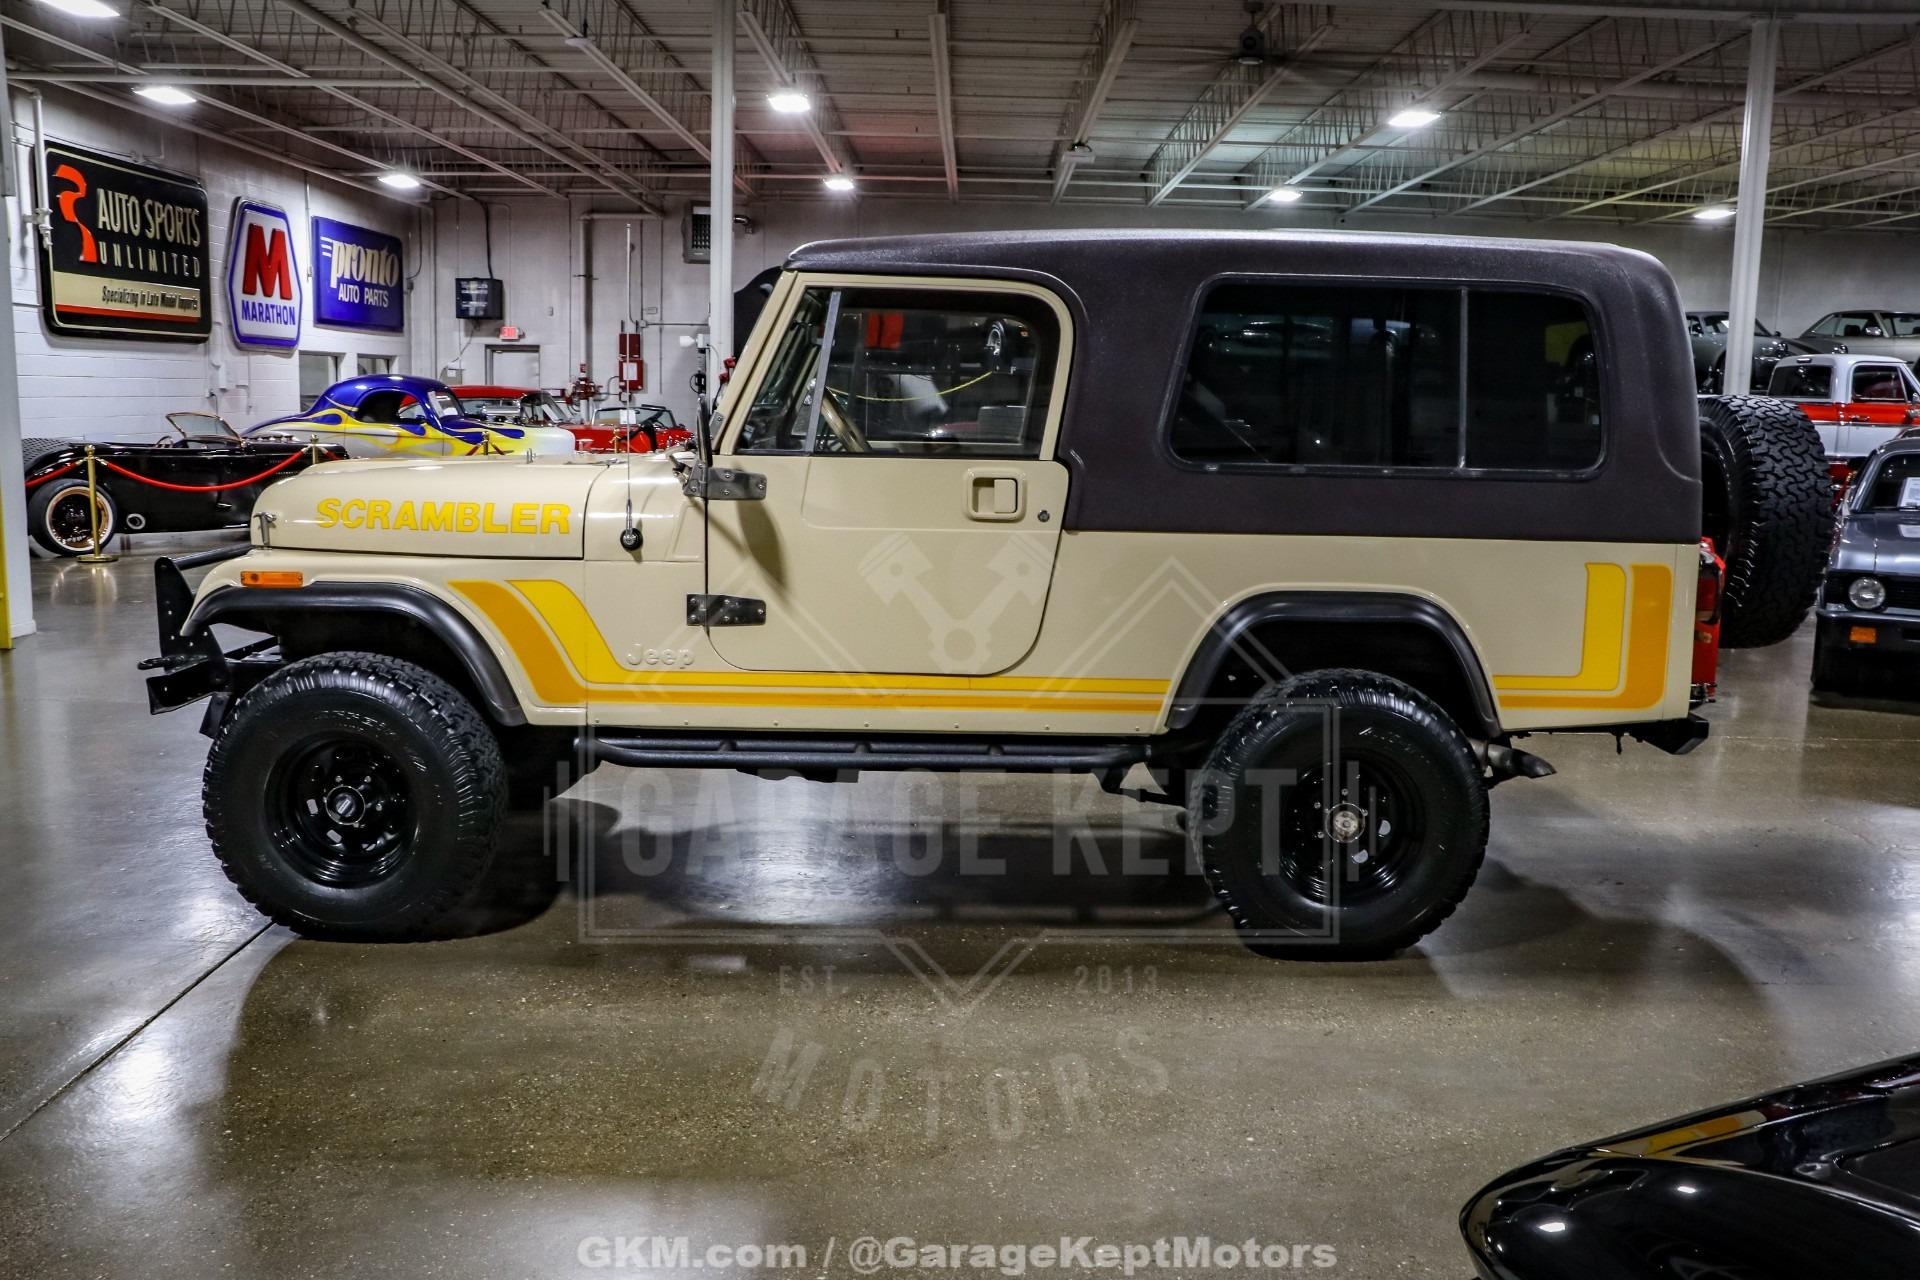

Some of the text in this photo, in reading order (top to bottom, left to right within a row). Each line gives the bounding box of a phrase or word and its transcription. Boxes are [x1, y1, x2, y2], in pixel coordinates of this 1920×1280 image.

[97, 187, 201, 248] AUTO SPORTS
[98, 240, 200, 278] UNLIMITED
[242, 223, 293, 301] M
[329, 239, 400, 289] pronto
[102, 284, 139, 307] Specializing
[139, 289, 146, 305] in
[241, 300, 296, 326] MARATHON
[338, 283, 389, 308] AUTO PARTS
[315, 497, 571, 535] SCRAMBLER
[625, 642, 695, 670] Jeep
